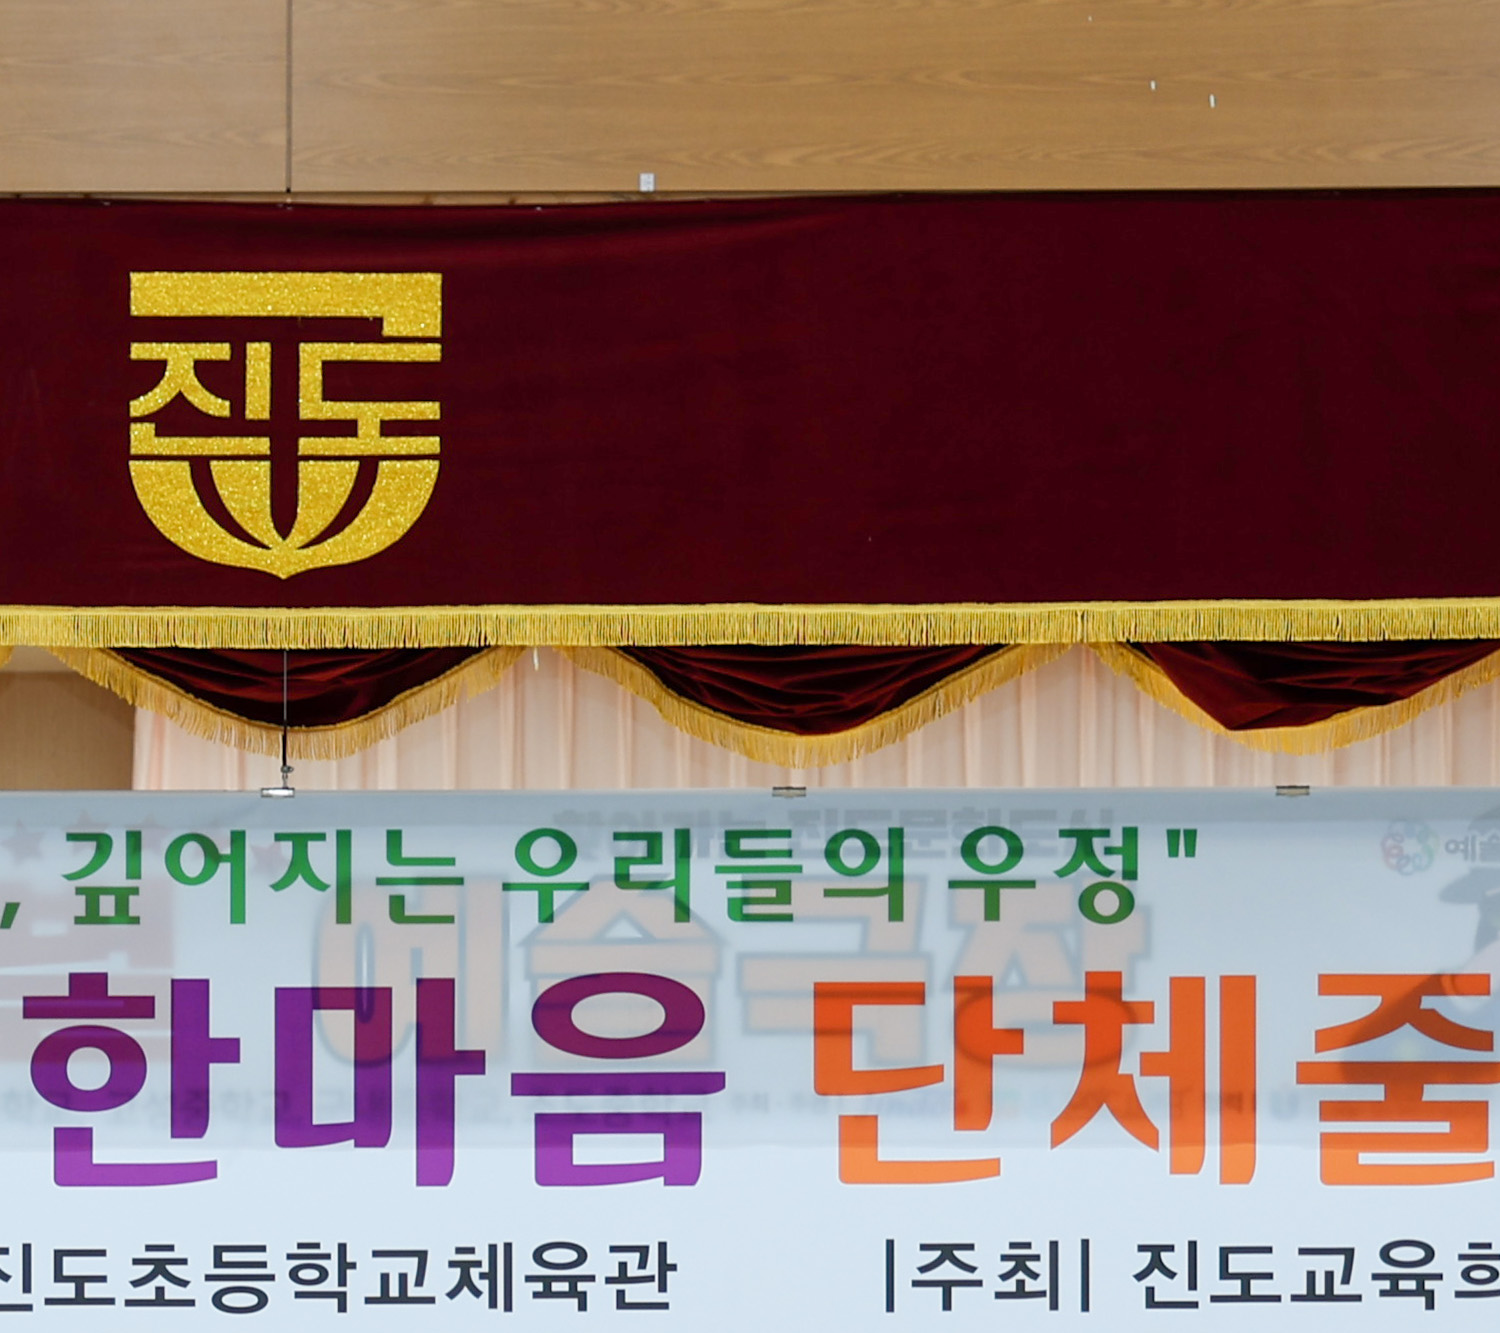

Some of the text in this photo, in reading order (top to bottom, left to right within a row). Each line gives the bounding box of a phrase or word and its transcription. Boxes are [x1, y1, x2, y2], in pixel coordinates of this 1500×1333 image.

[130, 342, 442, 455] 진도
[64, 829, 465, 926] 깊어지는
[502, 827, 906, 924] 우리들의
[948, 827, 1200, 925] 우정"
[23, 972, 727, 1188] 한마음
